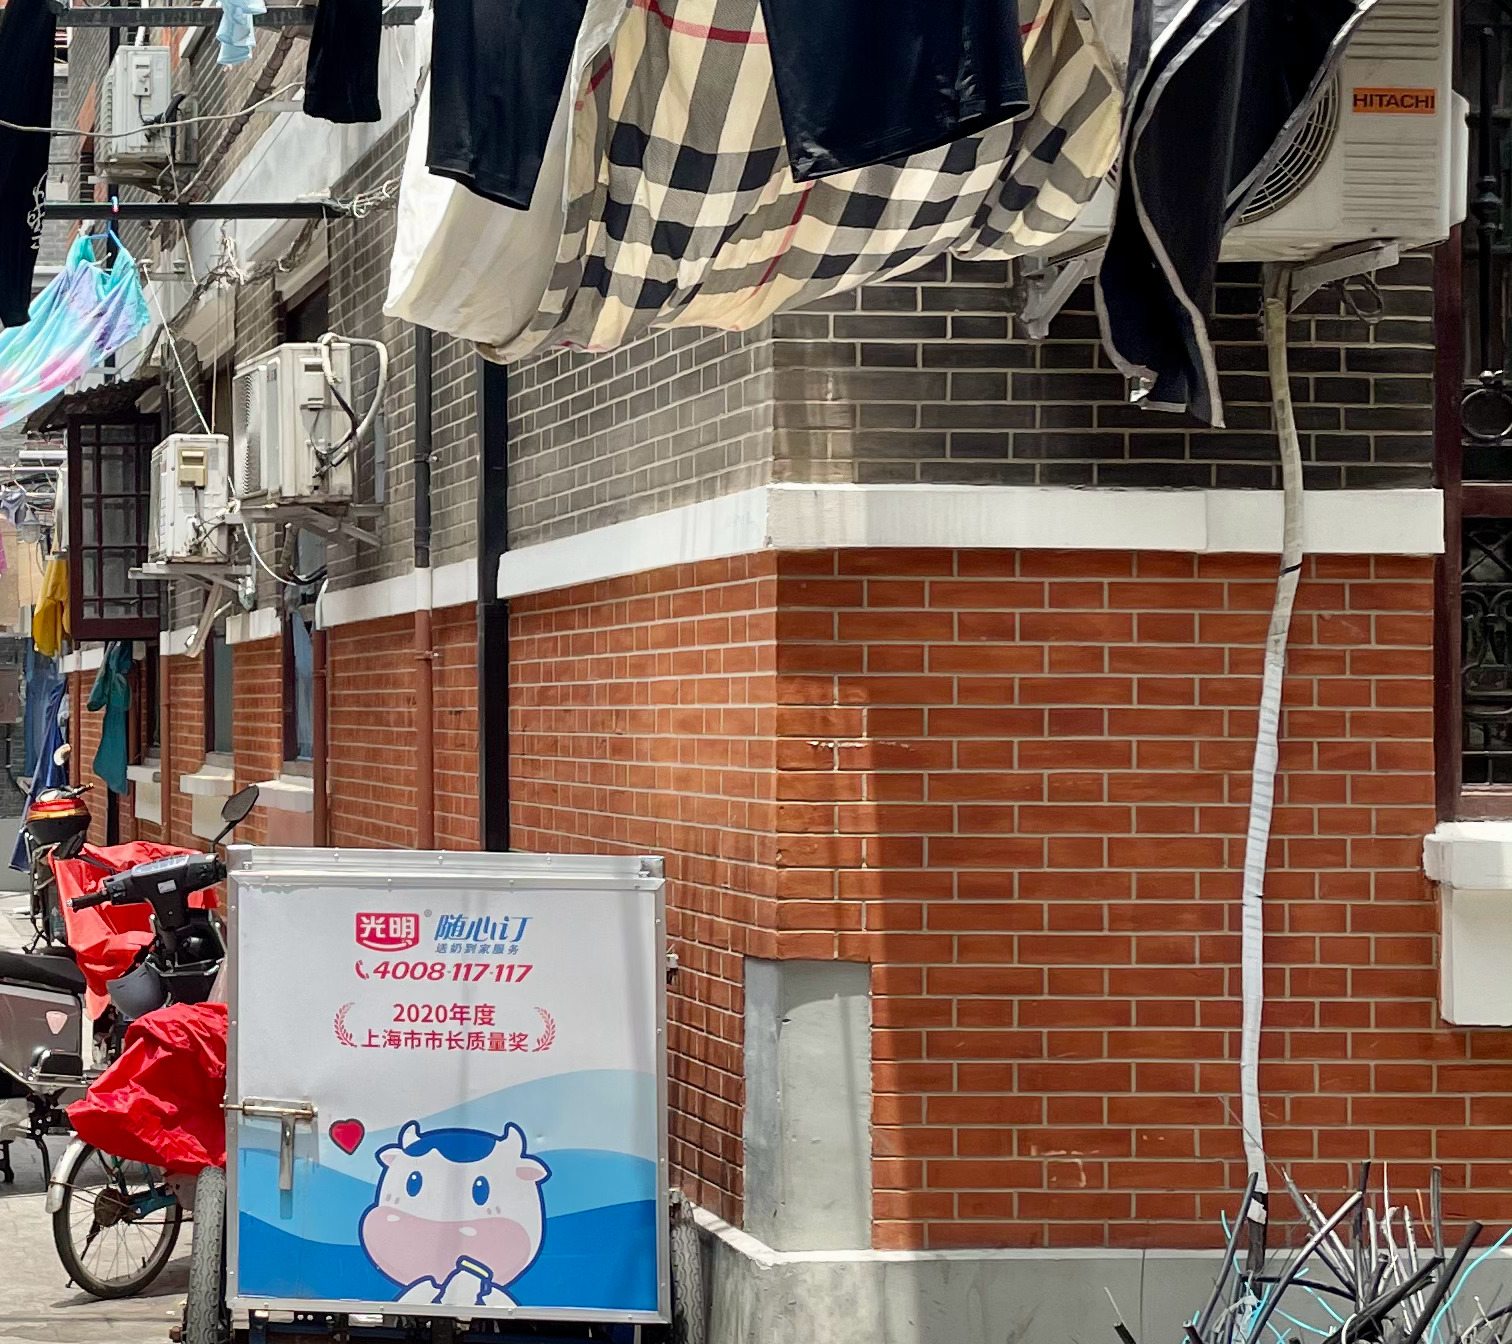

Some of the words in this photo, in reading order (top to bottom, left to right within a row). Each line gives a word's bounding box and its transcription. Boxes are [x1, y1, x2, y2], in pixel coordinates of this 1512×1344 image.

[1353, 93, 1435, 109] HITACHI
[359, 915, 416, 940] 光明
[434, 913, 534, 943] 随心订
[435, 942, 520, 956] 送奶到家服务
[392, 1002, 496, 1027] 2020年度
[360, 1028, 530, 1053] 上海市市长质量奖
